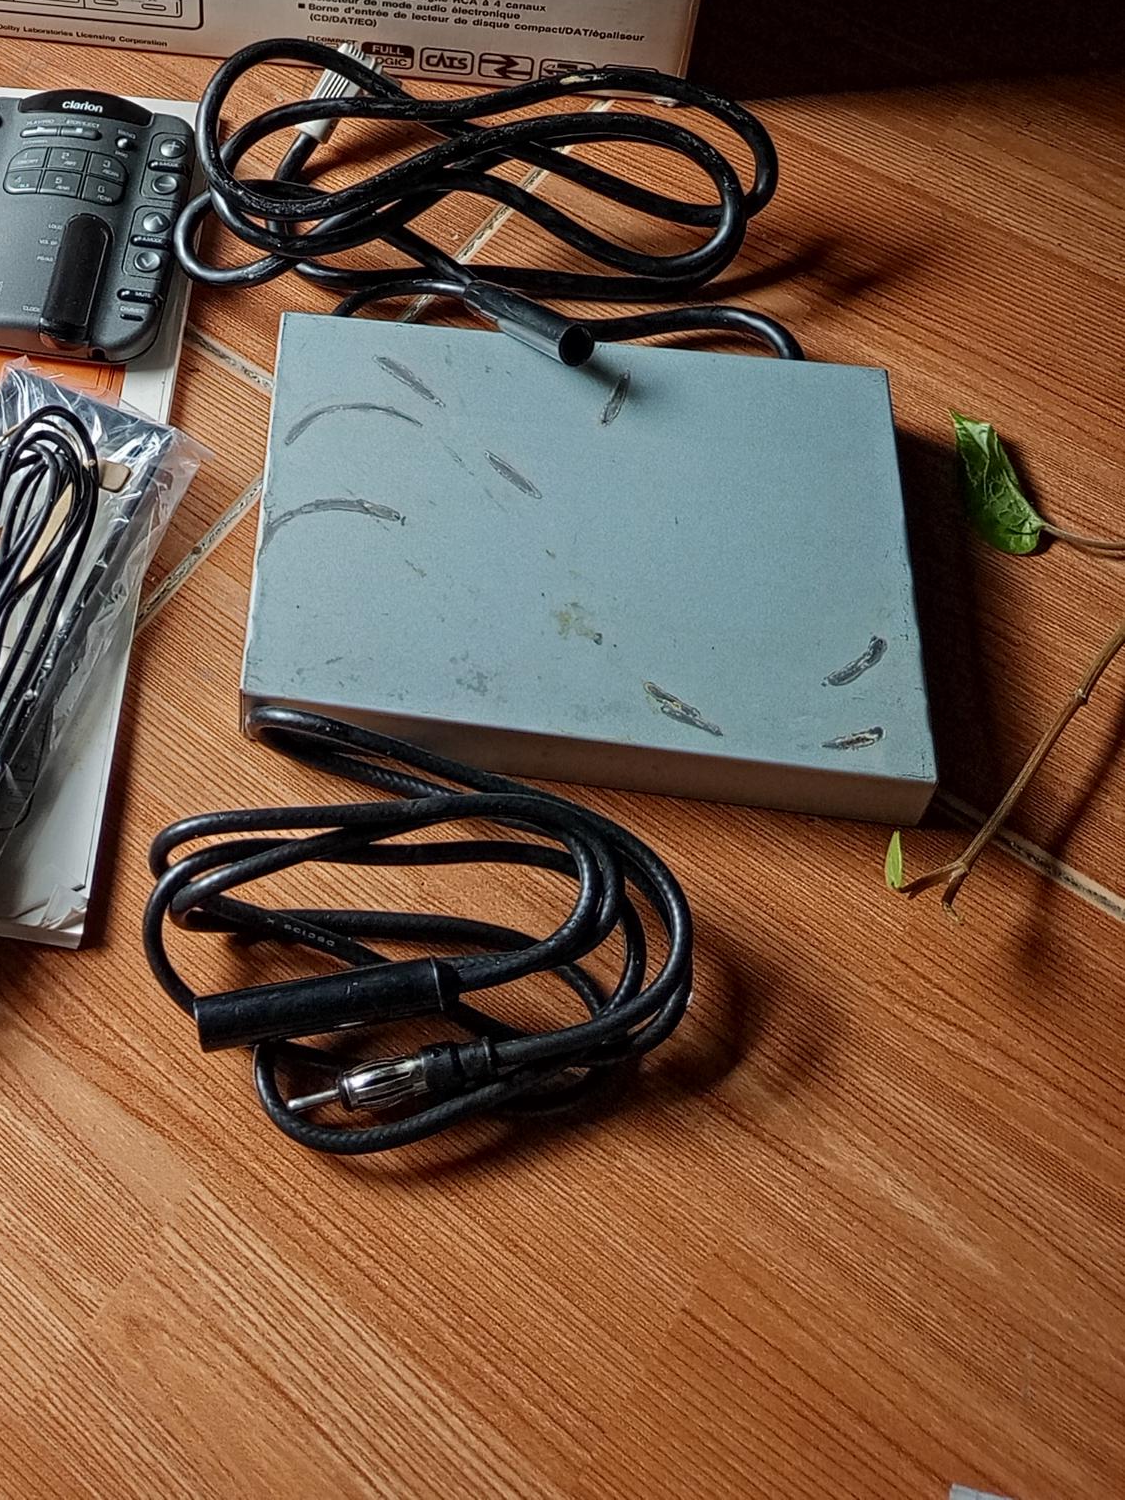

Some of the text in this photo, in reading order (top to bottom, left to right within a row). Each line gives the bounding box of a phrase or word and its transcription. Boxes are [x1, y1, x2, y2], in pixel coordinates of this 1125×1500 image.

[308, 2, 340, 13] Borne
[393, 10, 408, 20] de
[411, 12, 451, 24] lecteur
[453, 16, 469, 26] de
[471, 18, 511, 30] disque
[381, 0, 413, 10] mode
[416, 3, 448, 14] audio
[450, 5, 521, 20] électronique
[309, 12, 378, 29] (CD/DAT/EQ)
[23, 25, 74, 37] Laboratories
[76, 31, 116, 43] Licensing
[118, 35, 168, 48] Corporation
[371, 44, 405, 57] FULL
[374, 56, 408, 67] OGIC
[62, 99, 104, 113] clarion
